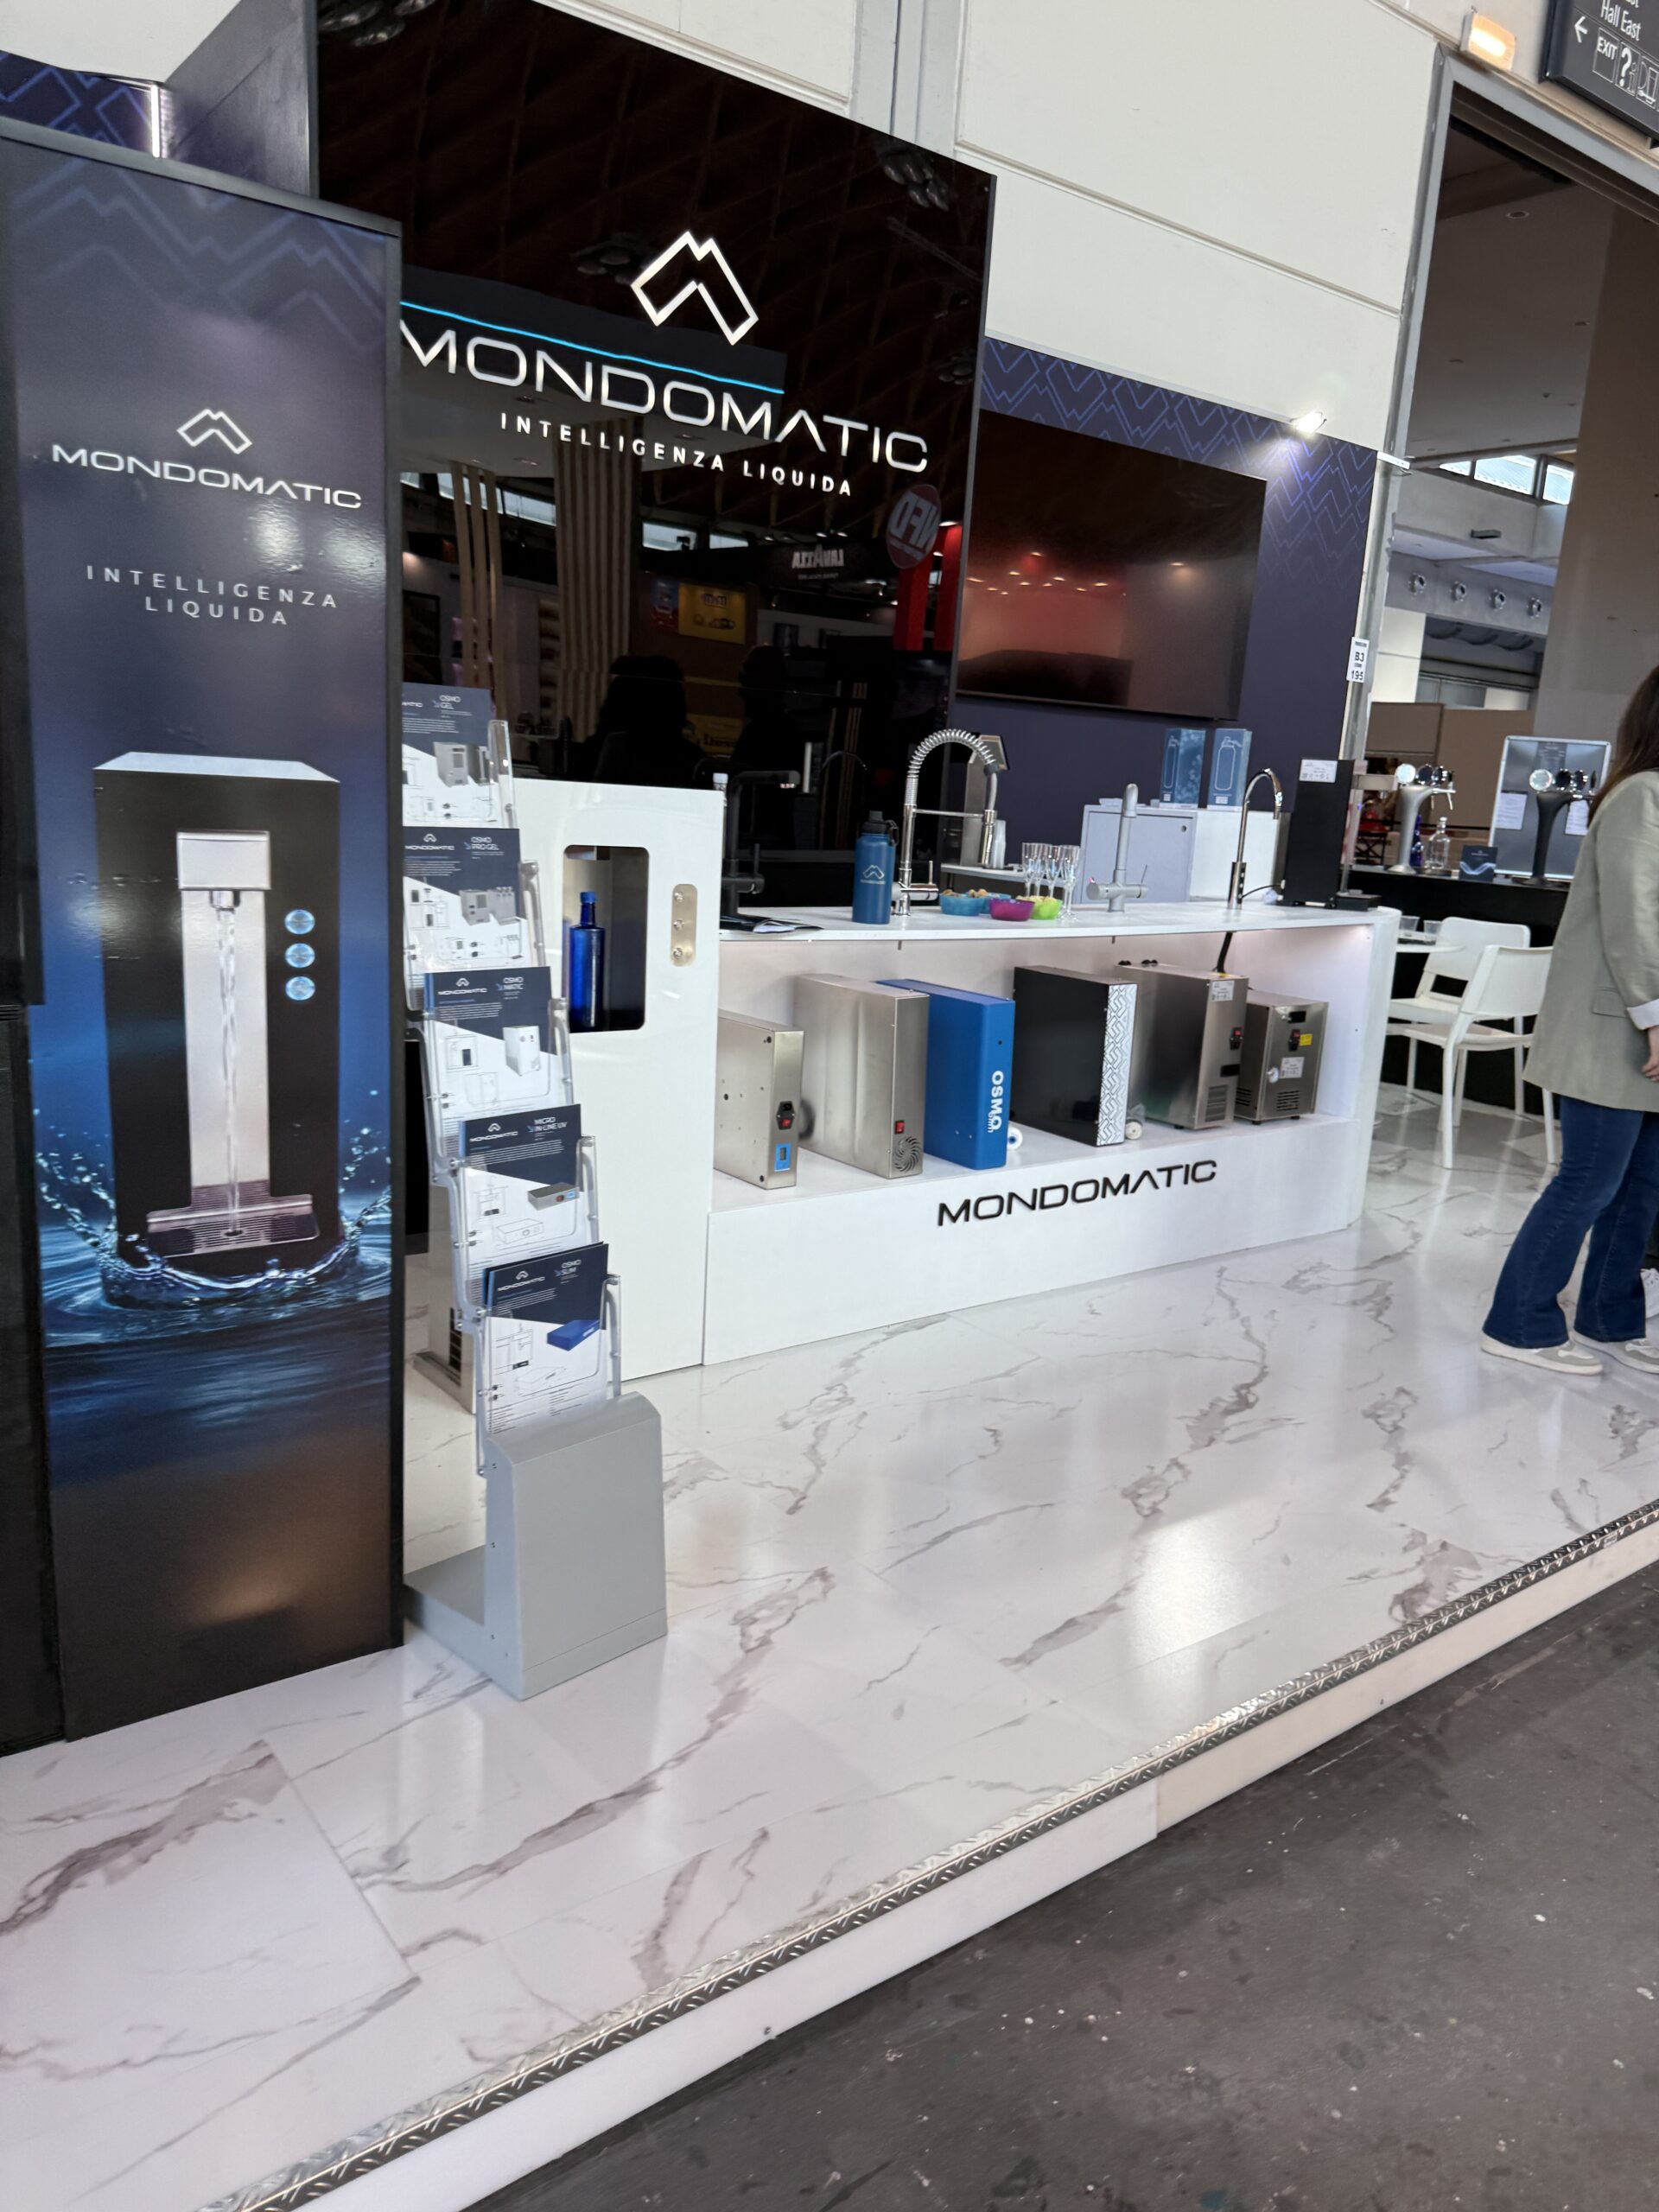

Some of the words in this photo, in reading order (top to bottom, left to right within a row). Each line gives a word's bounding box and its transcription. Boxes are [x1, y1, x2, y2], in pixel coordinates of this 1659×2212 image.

[1600, 0, 1621, 28] Hall
[1620, 10, 1641, 41] East
[1597, 36, 1618, 60] EXIT
[399, 318, 929, 474] MONDOMATIC
[51, 443, 363, 510] MONDOMATIC
[501, 411, 724, 473] INTELLIGENZA
[743, 460, 851, 497] LIQUIDA
[86, 564, 337, 608] INTELLIGENZA
[144, 596, 288, 626] LIQUIDA
[1354, 652, 1364, 663] B3
[990, 1070, 1004, 1130] OSMO
[938, 1160, 1217, 1227] MONDOMATIC
